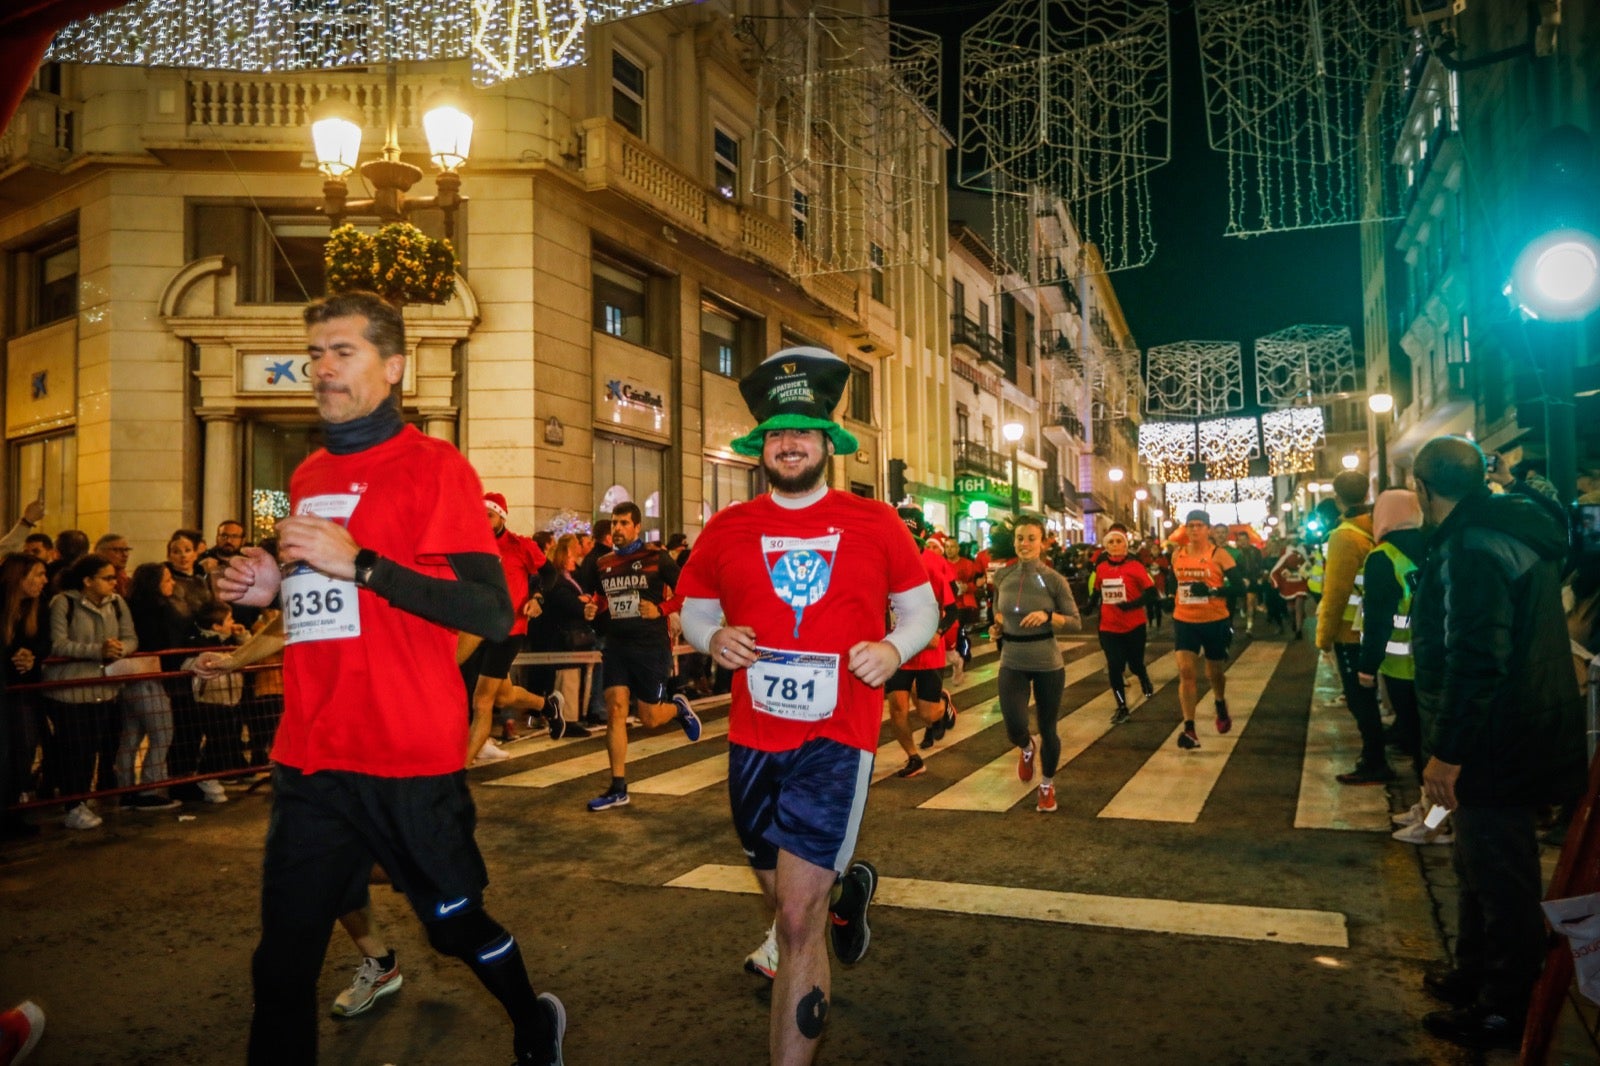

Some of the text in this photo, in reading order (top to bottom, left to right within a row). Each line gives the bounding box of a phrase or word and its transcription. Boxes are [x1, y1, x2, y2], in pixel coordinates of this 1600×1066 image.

[957, 479, 985, 492] 16H
[770, 540, 784, 548] 30
[613, 600, 632, 611] 757
[764, 674, 815, 702] 781
